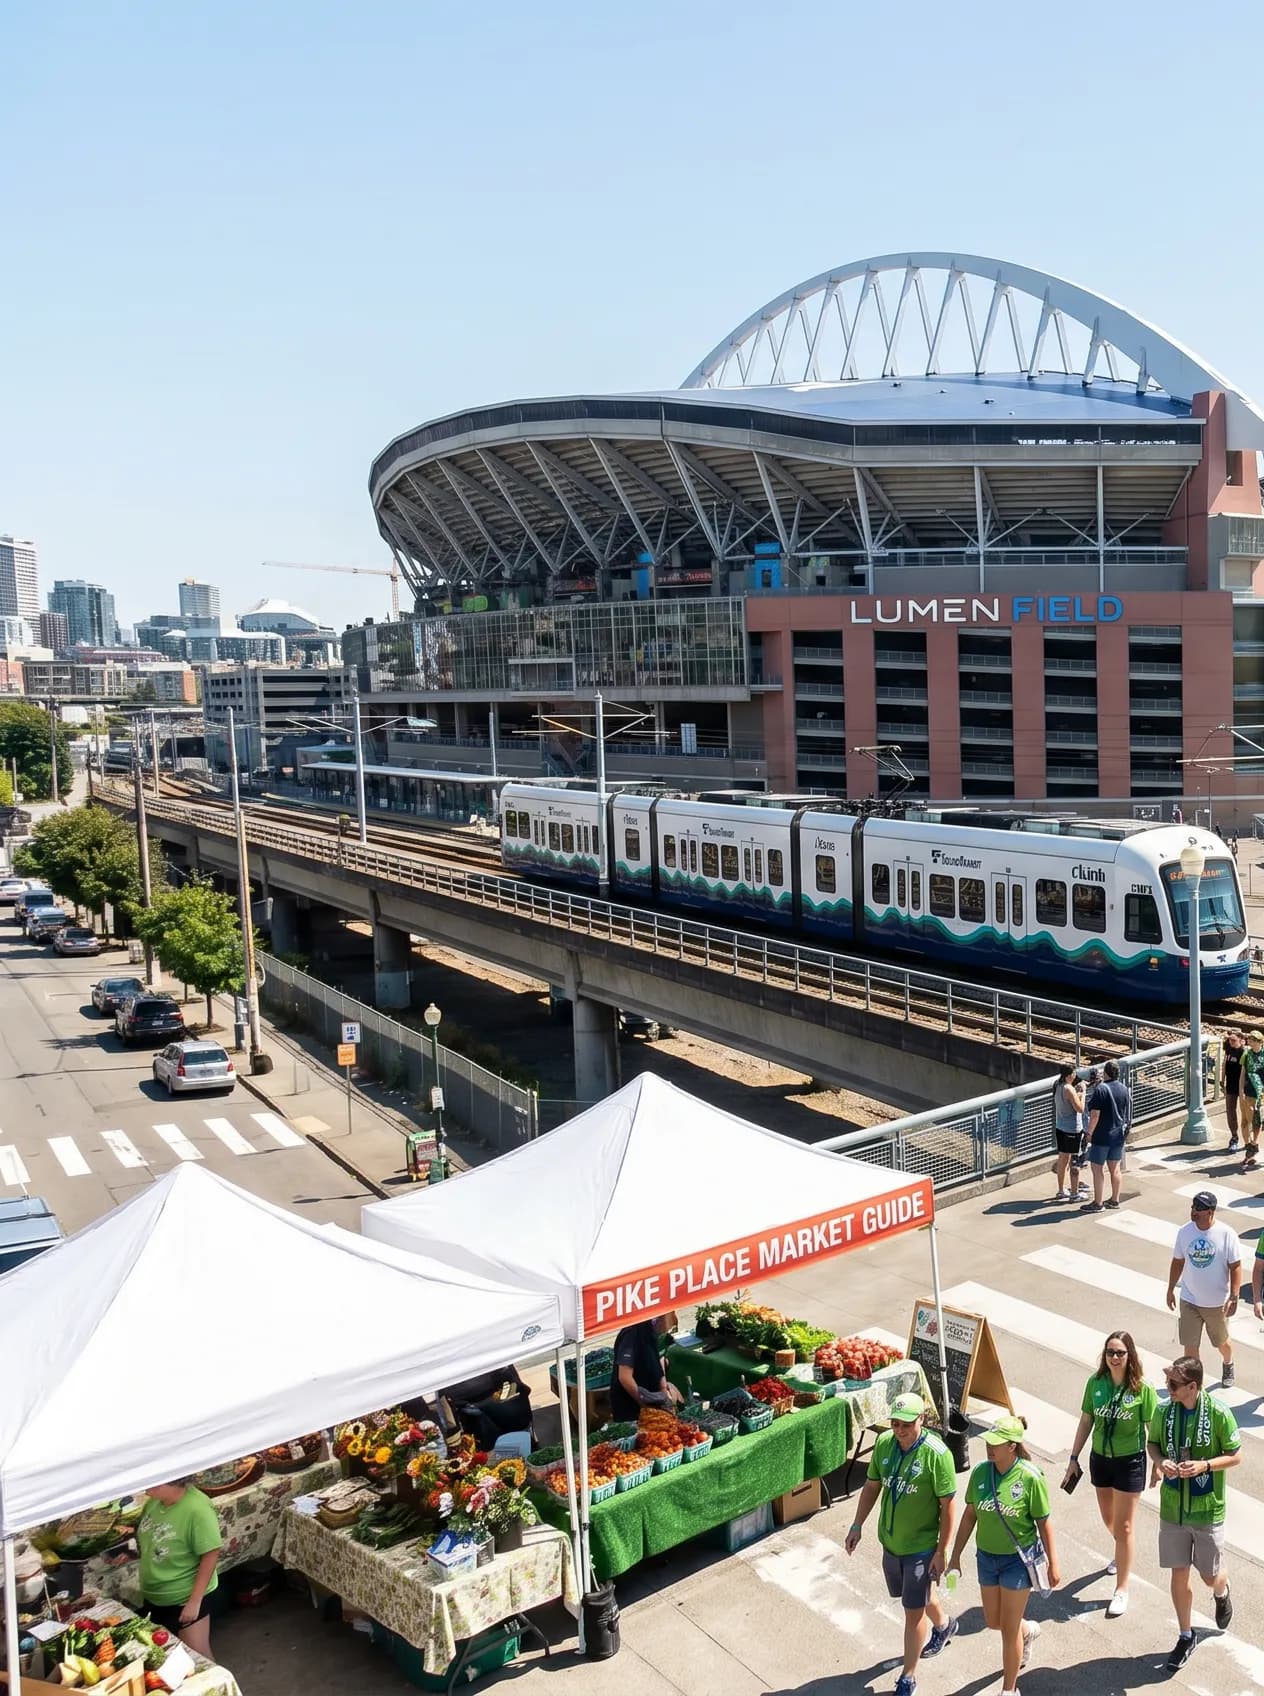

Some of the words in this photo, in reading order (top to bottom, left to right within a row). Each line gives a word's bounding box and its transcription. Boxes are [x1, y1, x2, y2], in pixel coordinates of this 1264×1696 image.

[850, 598, 999, 624] LUMEN
[1011, 595, 1123, 623] FIELD
[596, 1275, 661, 1323] PIKE
[668, 1246, 751, 1300] PLACE
[757, 1212, 856, 1270] MARKET
[862, 1190, 926, 1235] GUIDE
